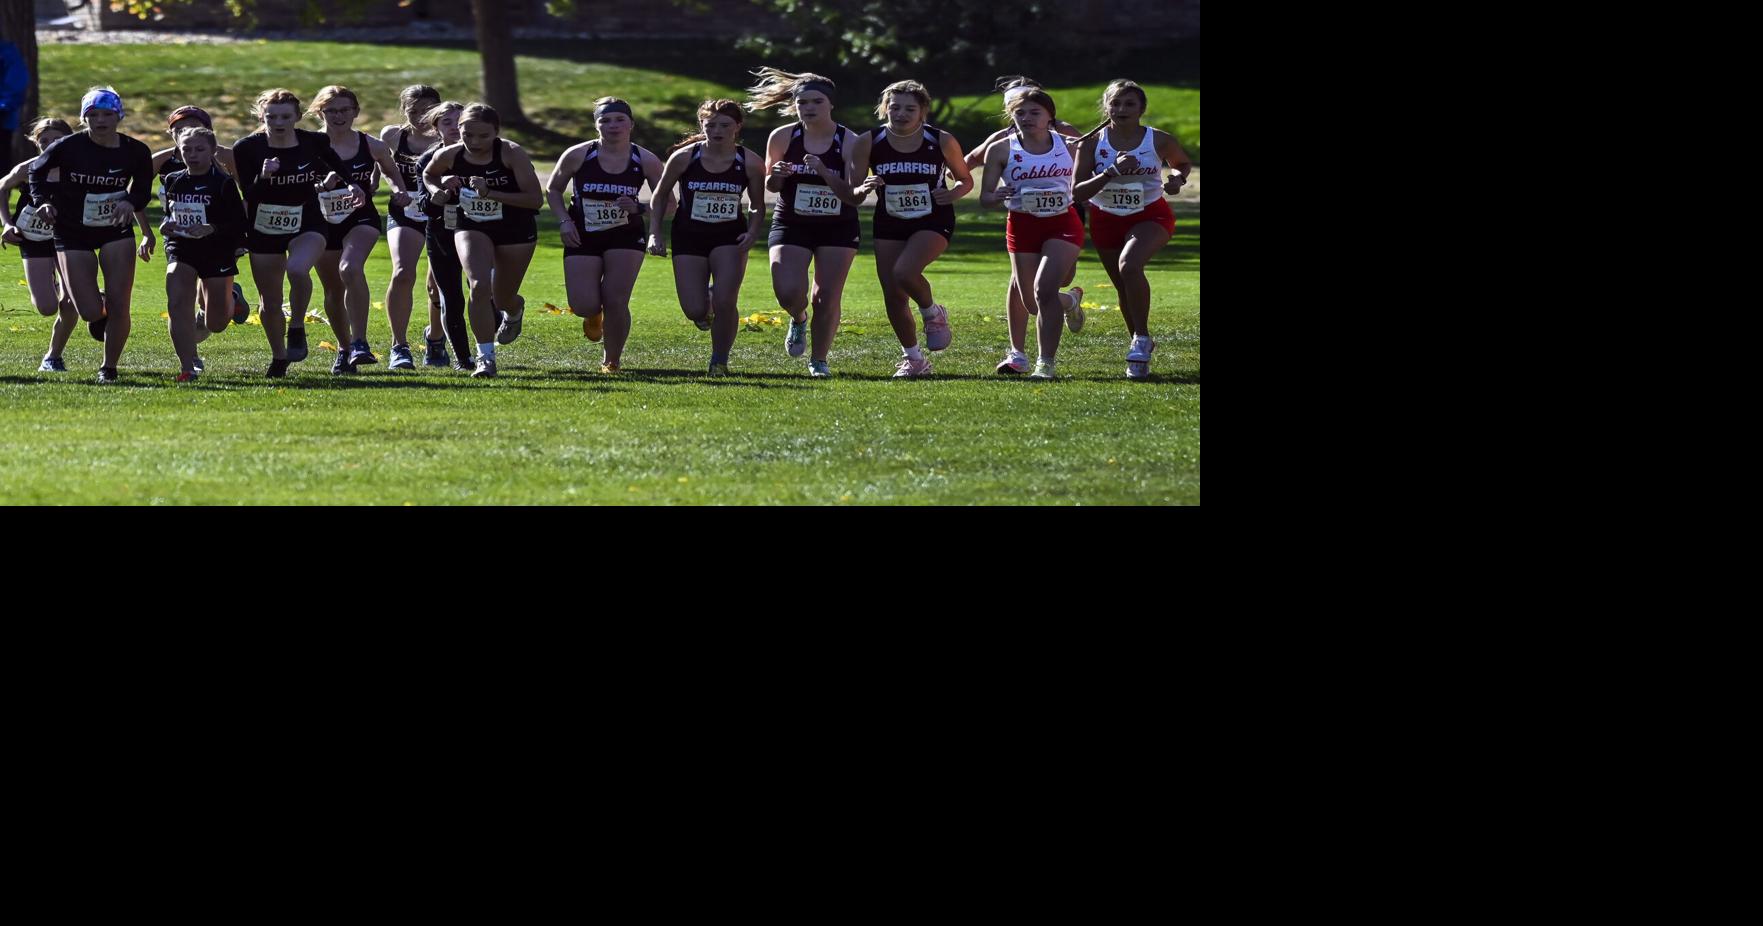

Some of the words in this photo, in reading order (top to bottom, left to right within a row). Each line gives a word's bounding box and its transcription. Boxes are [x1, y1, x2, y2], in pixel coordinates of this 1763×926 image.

[876, 162, 937, 175] SPEARFISH
[1011, 163, 1072, 181] Cobblers
[69, 172, 127, 187] STURGIS
[270, 170, 315, 186] TURGIS
[582, 183, 638, 196] SPEARFISH
[687, 181, 742, 193] SPEARFISH
[808, 196, 838, 209] 1860
[898, 195, 929, 208] 1864
[1035, 196, 1064, 208] 1793
[1112, 194, 1141, 205] 1798
[470, 201, 499, 212] 1882
[705, 202, 735, 214] 1863
[177, 214, 202, 226] 1888
[596, 208, 626, 220] 1862
[268, 215, 298, 228] 1890
